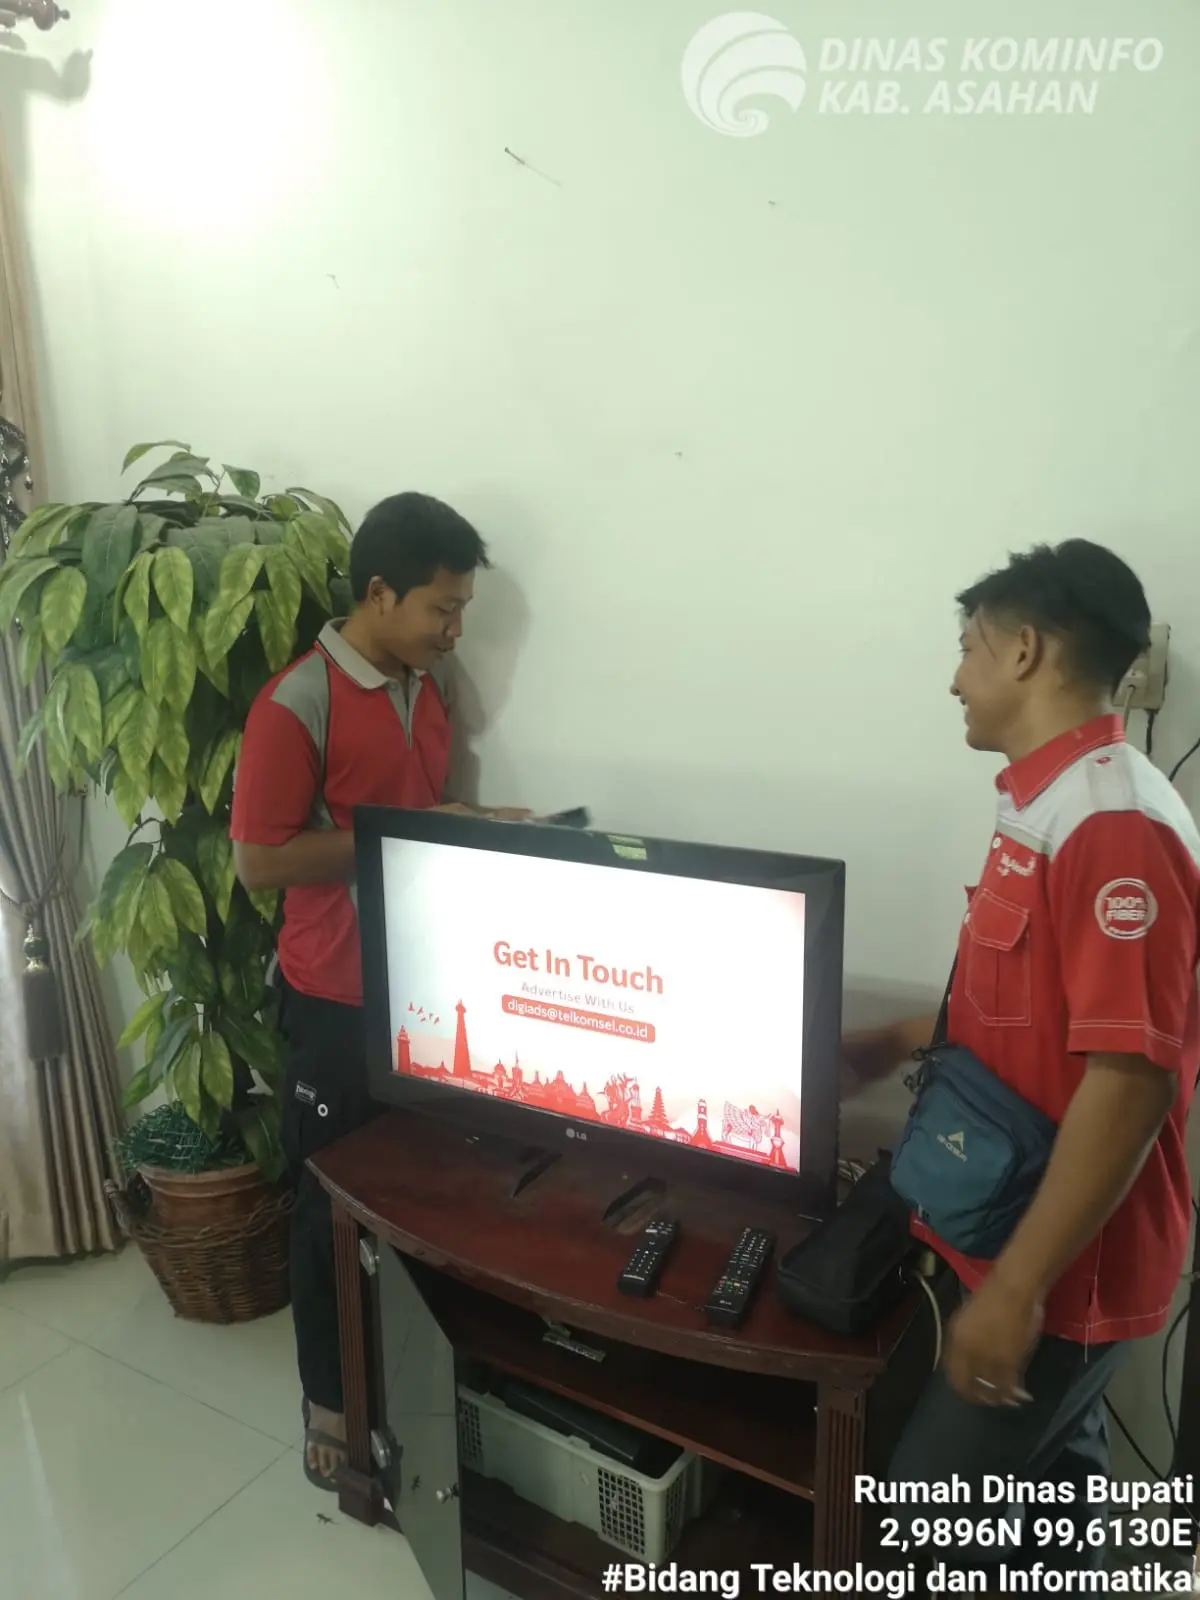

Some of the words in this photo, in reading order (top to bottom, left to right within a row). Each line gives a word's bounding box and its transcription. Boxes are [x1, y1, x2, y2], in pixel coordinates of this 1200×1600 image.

[493, 940, 539, 972] Get
[546, 949, 571, 978] In
[576, 954, 664, 995] Touch
[521, 981, 581, 1004] Advertise
[584, 992, 616, 1010] With
[618, 1000, 635, 1014] Us
[507, 999, 648, 1039] digiads@telkomsel.co.id
